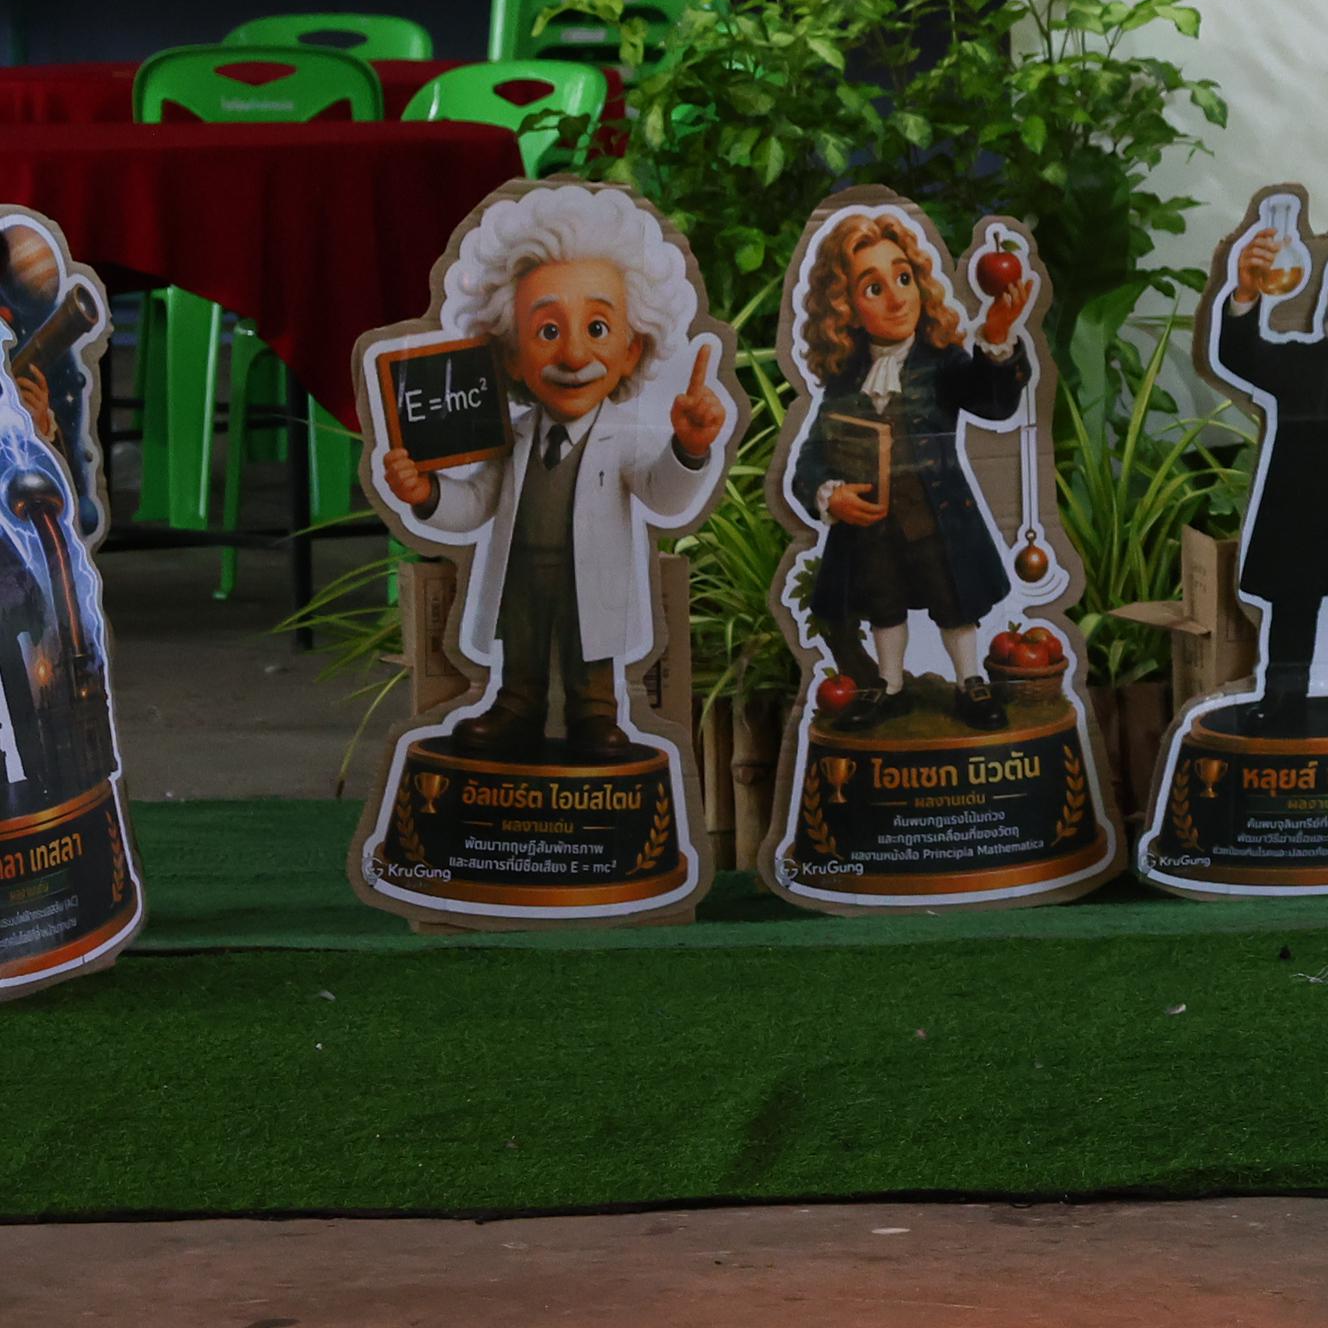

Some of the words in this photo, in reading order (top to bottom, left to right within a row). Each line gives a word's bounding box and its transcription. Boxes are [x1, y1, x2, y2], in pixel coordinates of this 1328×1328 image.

[968, 751, 1041, 784] นิวตัน
[1242, 760, 1319, 798] หลุยส์
[462, 779, 543, 810] อัลเบิร์ต
[550, 782, 643, 812] ไอน์สไตน์
[914, 792, 986, 809] ผลงานเด่น
[502, 818, 574, 834] ผลงานเด่น
[0, 848, 25, 880] ลา
[30, 832, 83, 872] เทสลา
[923, 847, 974, 861] Principia
[977, 838, 1044, 857] Mathematica
[449, 854, 567, 873] และสมการที่มีชื่อเสียง
[570, 863, 579, 873] E
[802, 861, 864, 877] KruGung
[1159, 854, 1211, 867] KruGung
[388, 863, 451, 882] KruGung
